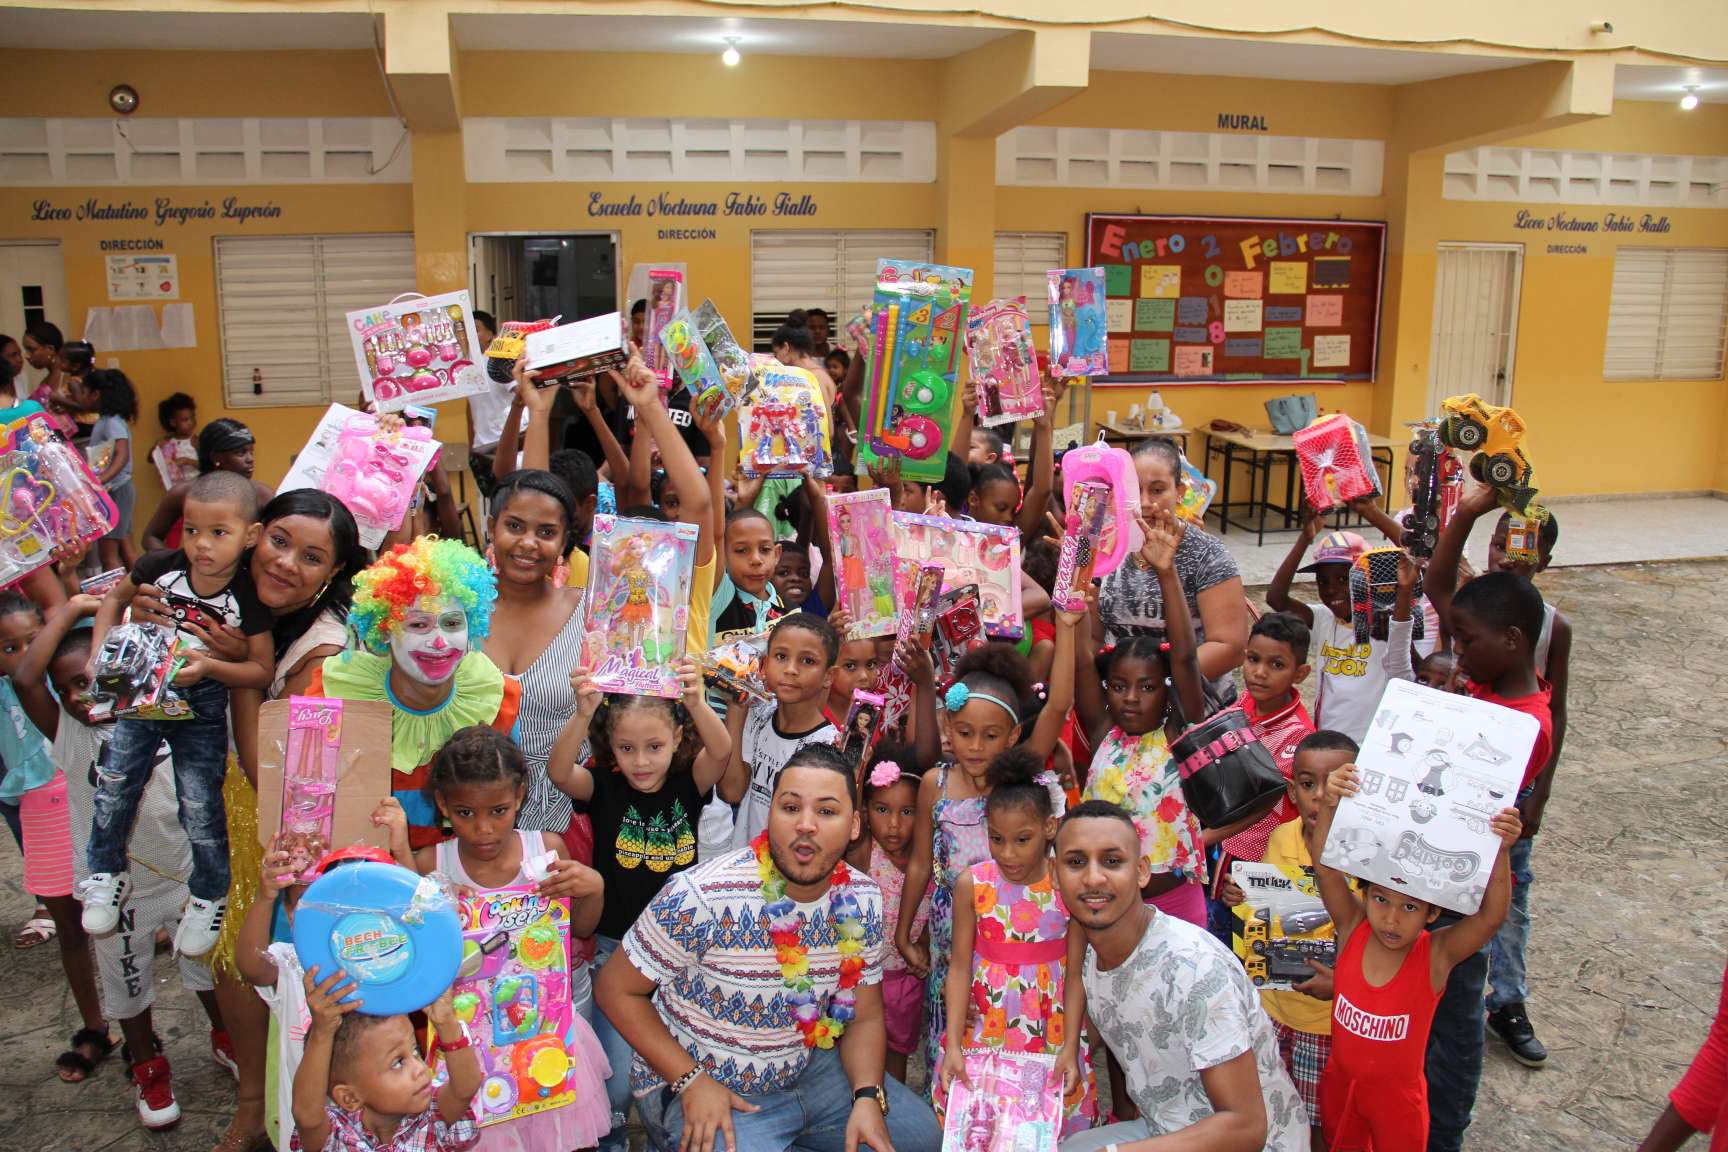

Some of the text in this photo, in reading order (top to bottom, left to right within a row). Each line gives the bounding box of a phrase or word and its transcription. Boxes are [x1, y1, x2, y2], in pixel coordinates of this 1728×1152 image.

[1217, 113, 1268, 131] MURAL
[31, 197, 281, 226] Liceo Matutino Gregorio Luperón
[587, 191, 818, 217] Escuela Nocturna Fabio Fiallo
[1515, 209, 1671, 234] Liceo Nocturno Fabio Fiallo
[100, 238, 164, 251] DIRECCIÓN
[657, 229, 717, 240] DIRECCIÓN
[1101, 224, 1352, 270] Enero Febrero
[1248, 876, 1293, 889] TRUCK
[117, 908, 142, 998] NIKE
[1336, 997, 1406, 1040] MOSCHINO
